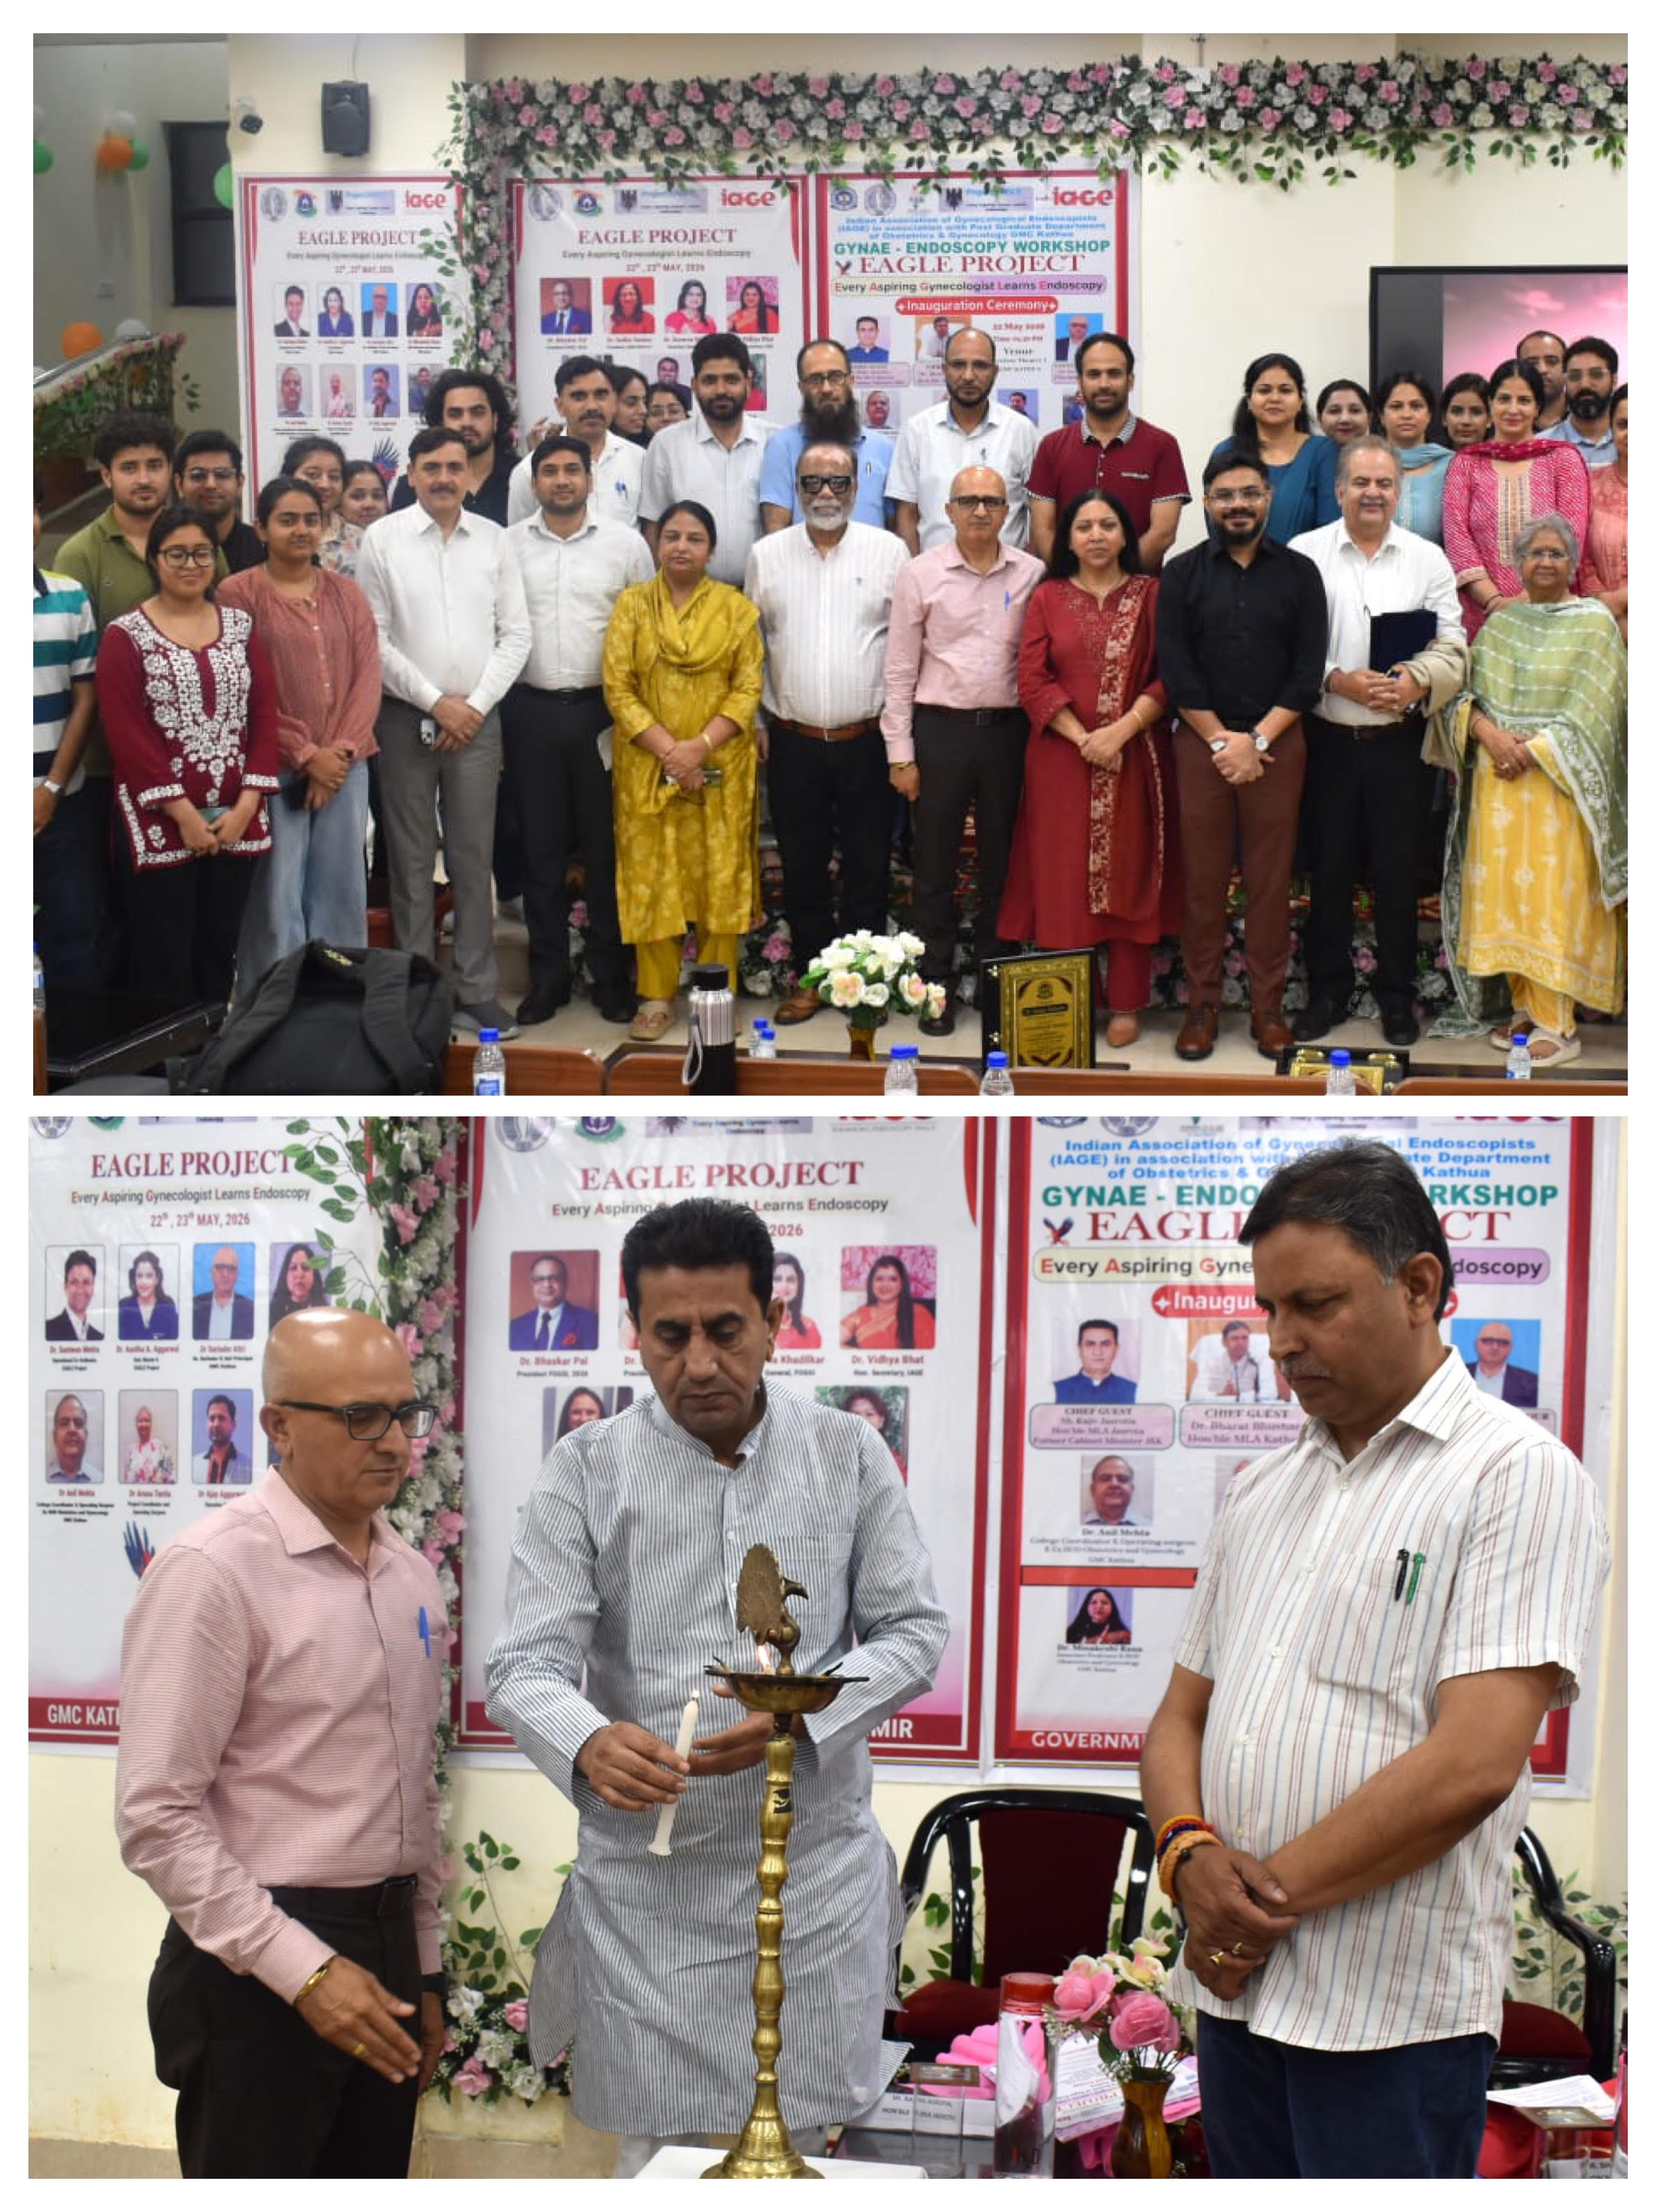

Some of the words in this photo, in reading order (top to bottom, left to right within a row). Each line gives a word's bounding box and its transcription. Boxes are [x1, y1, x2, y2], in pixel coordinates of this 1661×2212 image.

[298, 230, 346, 245] EAGLE
[352, 229, 417, 246] PROJECT
[578, 229, 644, 245] EAGLE
[649, 228, 737, 245] PROJECT
[834, 241, 890, 255] GYNAE
[907, 240, 1008, 254] ENDOSCOPY
[1014, 239, 1111, 253] WORKSHOP
[860, 257, 954, 273] EAGLE
[961, 255, 1085, 275] PROJECT
[835, 282, 866, 296] Every
[869, 282, 917, 296] Aspiring
[920, 281, 995, 295] Gynecologist
[997, 281, 1036, 291] Learns
[1039, 280, 1104, 293] Endoscopy
[907, 300, 983, 314] Inauguration
[986, 299, 1049, 313] Ceremony
[1065, 1140, 1122, 1152] Indian
[1128, 1139, 1237, 1151] Association
[1244, 1137, 1262, 1149] of
[1408, 1138, 1536, 1152] Endoscopists
[91, 1152, 174, 1178] EAGLE
[180, 1149, 289, 1177] PROJECT
[1050, 1154, 1108, 1168] (IAGE)
[1114, 1154, 1131, 1165] in
[1137, 1153, 1244, 1165] association
[1251, 1153, 1290, 1163] with
[1439, 1152, 1551, 1165] Department
[580, 1165, 695, 1191] EAGLE
[705, 1161, 864, 1189] PROJECT
[1108, 1167, 1127, 1179] of
[1132, 1167, 1228, 1179] Obstetrics
[1237, 1167, 1249, 1178] &
[1422, 1166, 1491, 1177] Kathua
[71, 1191, 99, 1206] Every
[102, 1190, 143, 1205] Aspiring
[145, 1188, 212, 1204] Gynecologist
[215, 1188, 250, 1201] Learns
[253, 1186, 310, 1202] Endoscopy
[1042, 1186, 1147, 1207] GYNAE
[1177, 1185, 1262, 1206] ENDO
[1428, 1184, 1558, 1206] RKSHOP
[552, 1204, 590, 1218] Every
[754, 1200, 804, 1212] Learns
[808, 1197, 889, 1213] Endoscopy
[197, 1213, 223, 1228] MAY,
[226, 1213, 250, 1226] 2026
[770, 1224, 803, 1237] 2026
[1041, 1258, 1098, 1276] Every
[1105, 1258, 1192, 1276] Aspiring
[1199, 1258, 1254, 1275] Gyne
[1453, 1258, 1543, 1278] doscopy
[520, 1357, 531, 1365] Dr.
[534, 1357, 571, 1365] Bhaskar
[574, 1357, 588, 1365] Pal
[624, 1357, 636, 1366] Dr.
[852, 1356, 864, 1364] Dr.
[902, 1355, 924, 1364] Bhat
[1204, 1409, 1244, 1418] CHIEF
[1247, 1410, 1289, 1418] GUEST
[1190, 1422, 1208, 1430] Dr.
[1235, 1435, 1261, 1443] MLA
[47, 1703, 82, 1724] GMC
[86, 1705, 120, 1726] KAT
[870, 1719, 914, 1739] MIR
[1032, 1731, 1145, 1750] GOVERNM
